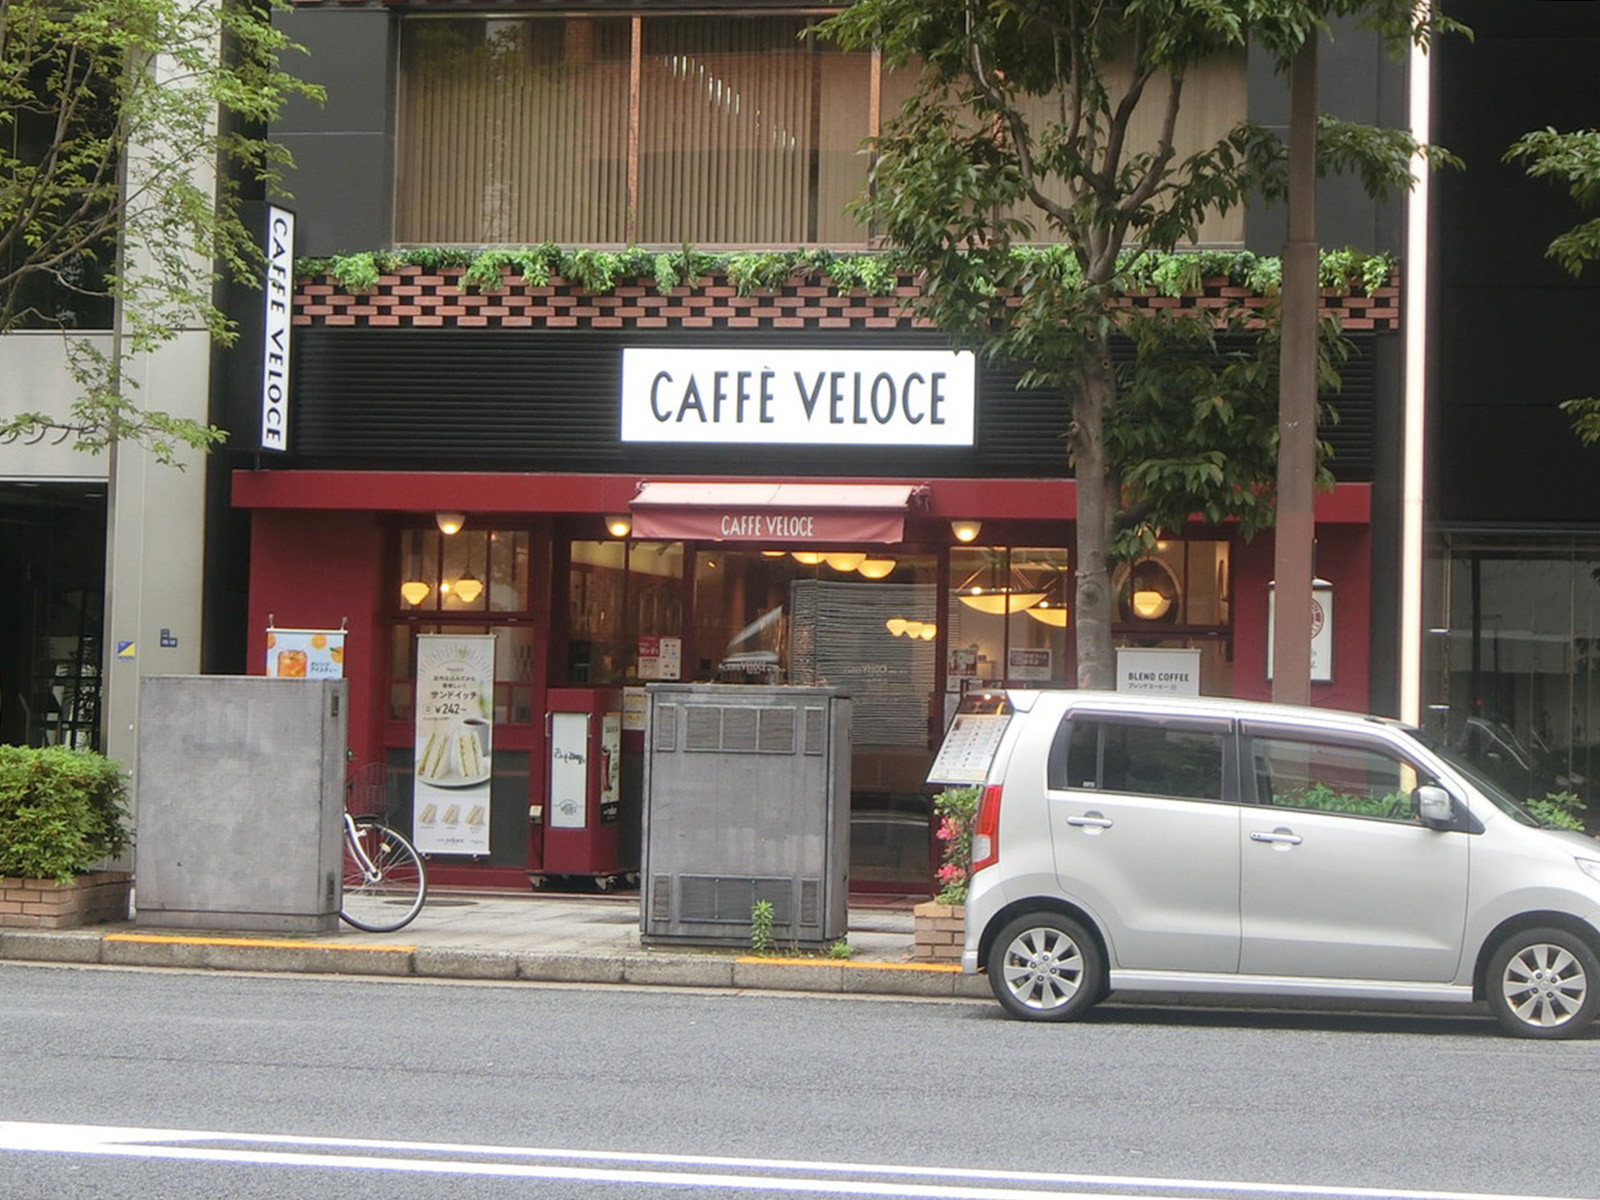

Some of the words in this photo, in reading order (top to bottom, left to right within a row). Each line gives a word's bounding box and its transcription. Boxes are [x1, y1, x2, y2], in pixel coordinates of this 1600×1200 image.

[266, 328, 284, 442] VELOCE
[650, 365, 776, 423] CAFFÈ
[793, 371, 947, 425] VELOCE
[766, 516, 814, 537] VELOCE
[1128, 672, 1156, 681] BLEND
[1158, 673, 1190, 682] COFFEE
[431, 691, 477, 700] サンドイッチ
